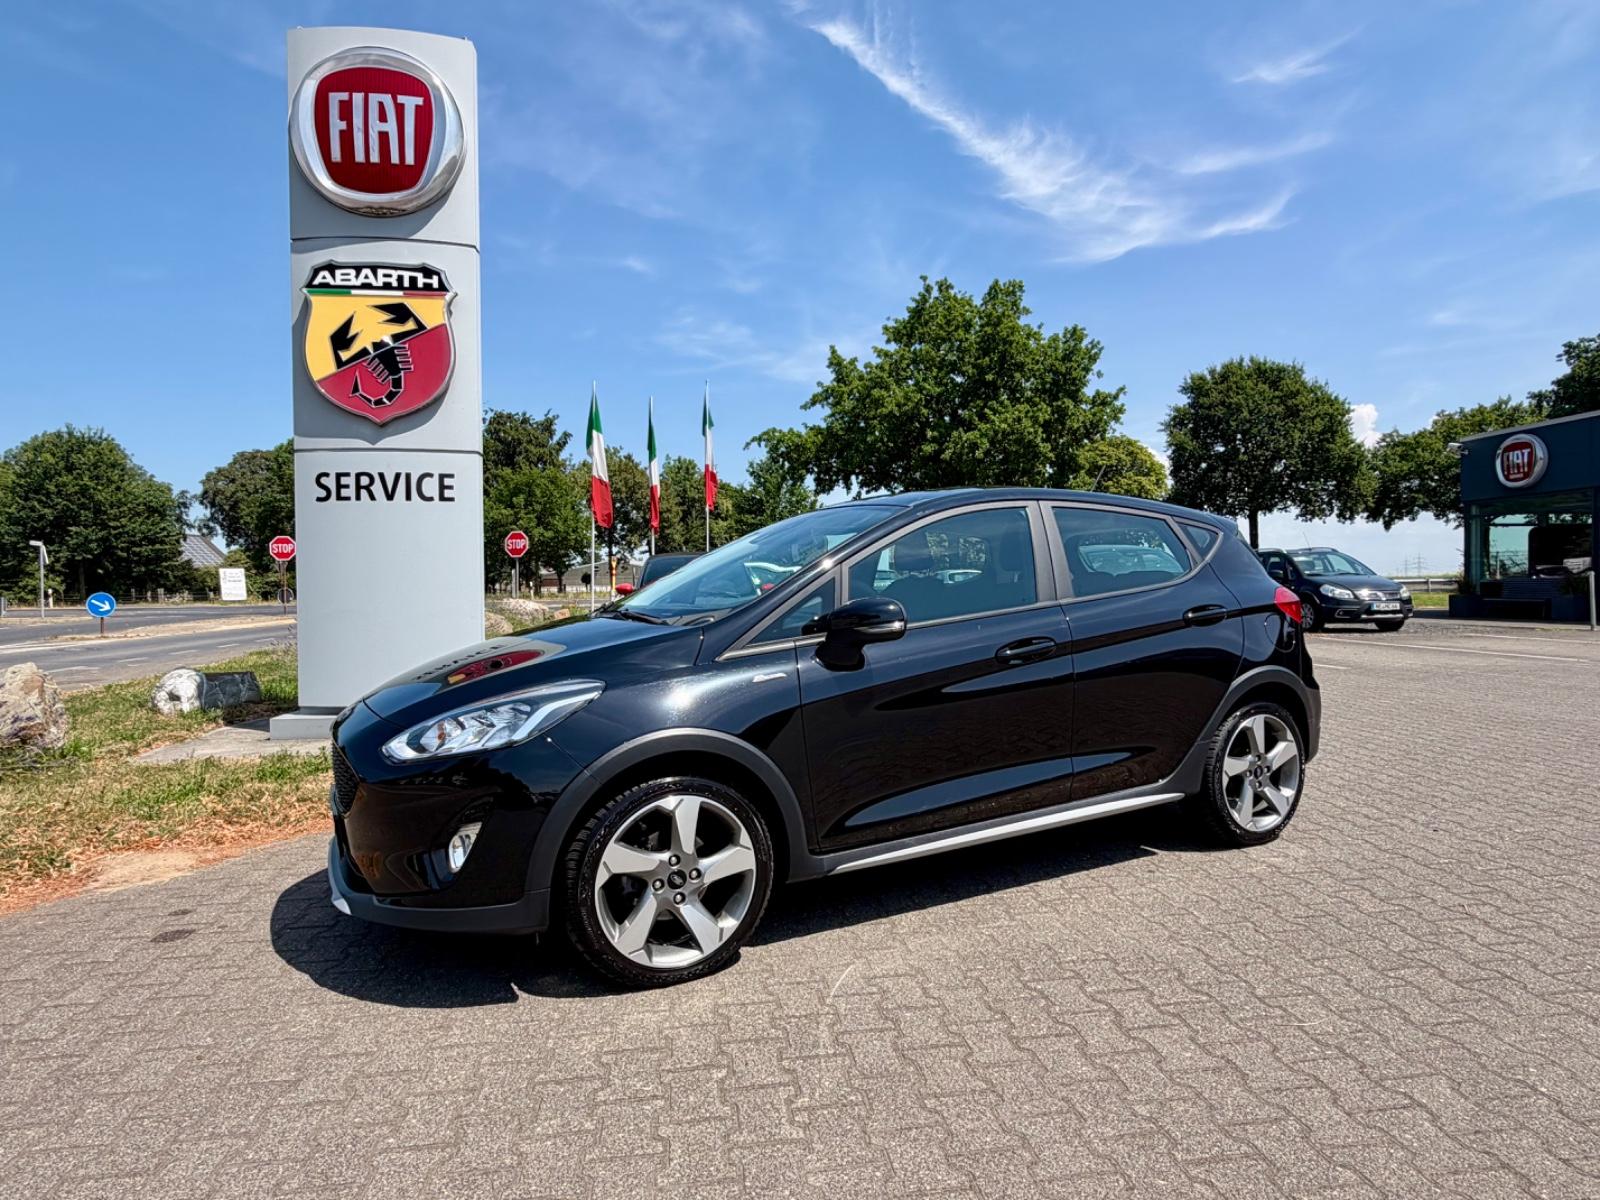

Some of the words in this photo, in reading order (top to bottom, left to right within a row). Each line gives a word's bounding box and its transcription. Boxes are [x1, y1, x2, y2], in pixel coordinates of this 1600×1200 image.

[328, 91, 424, 165] FIAT
[312, 268, 439, 289] ABARTH
[1503, 448, 1531, 475] FIAT
[315, 472, 456, 502] SERVICE
[272, 543, 294, 554] STOP
[507, 539, 526, 550] STOP
